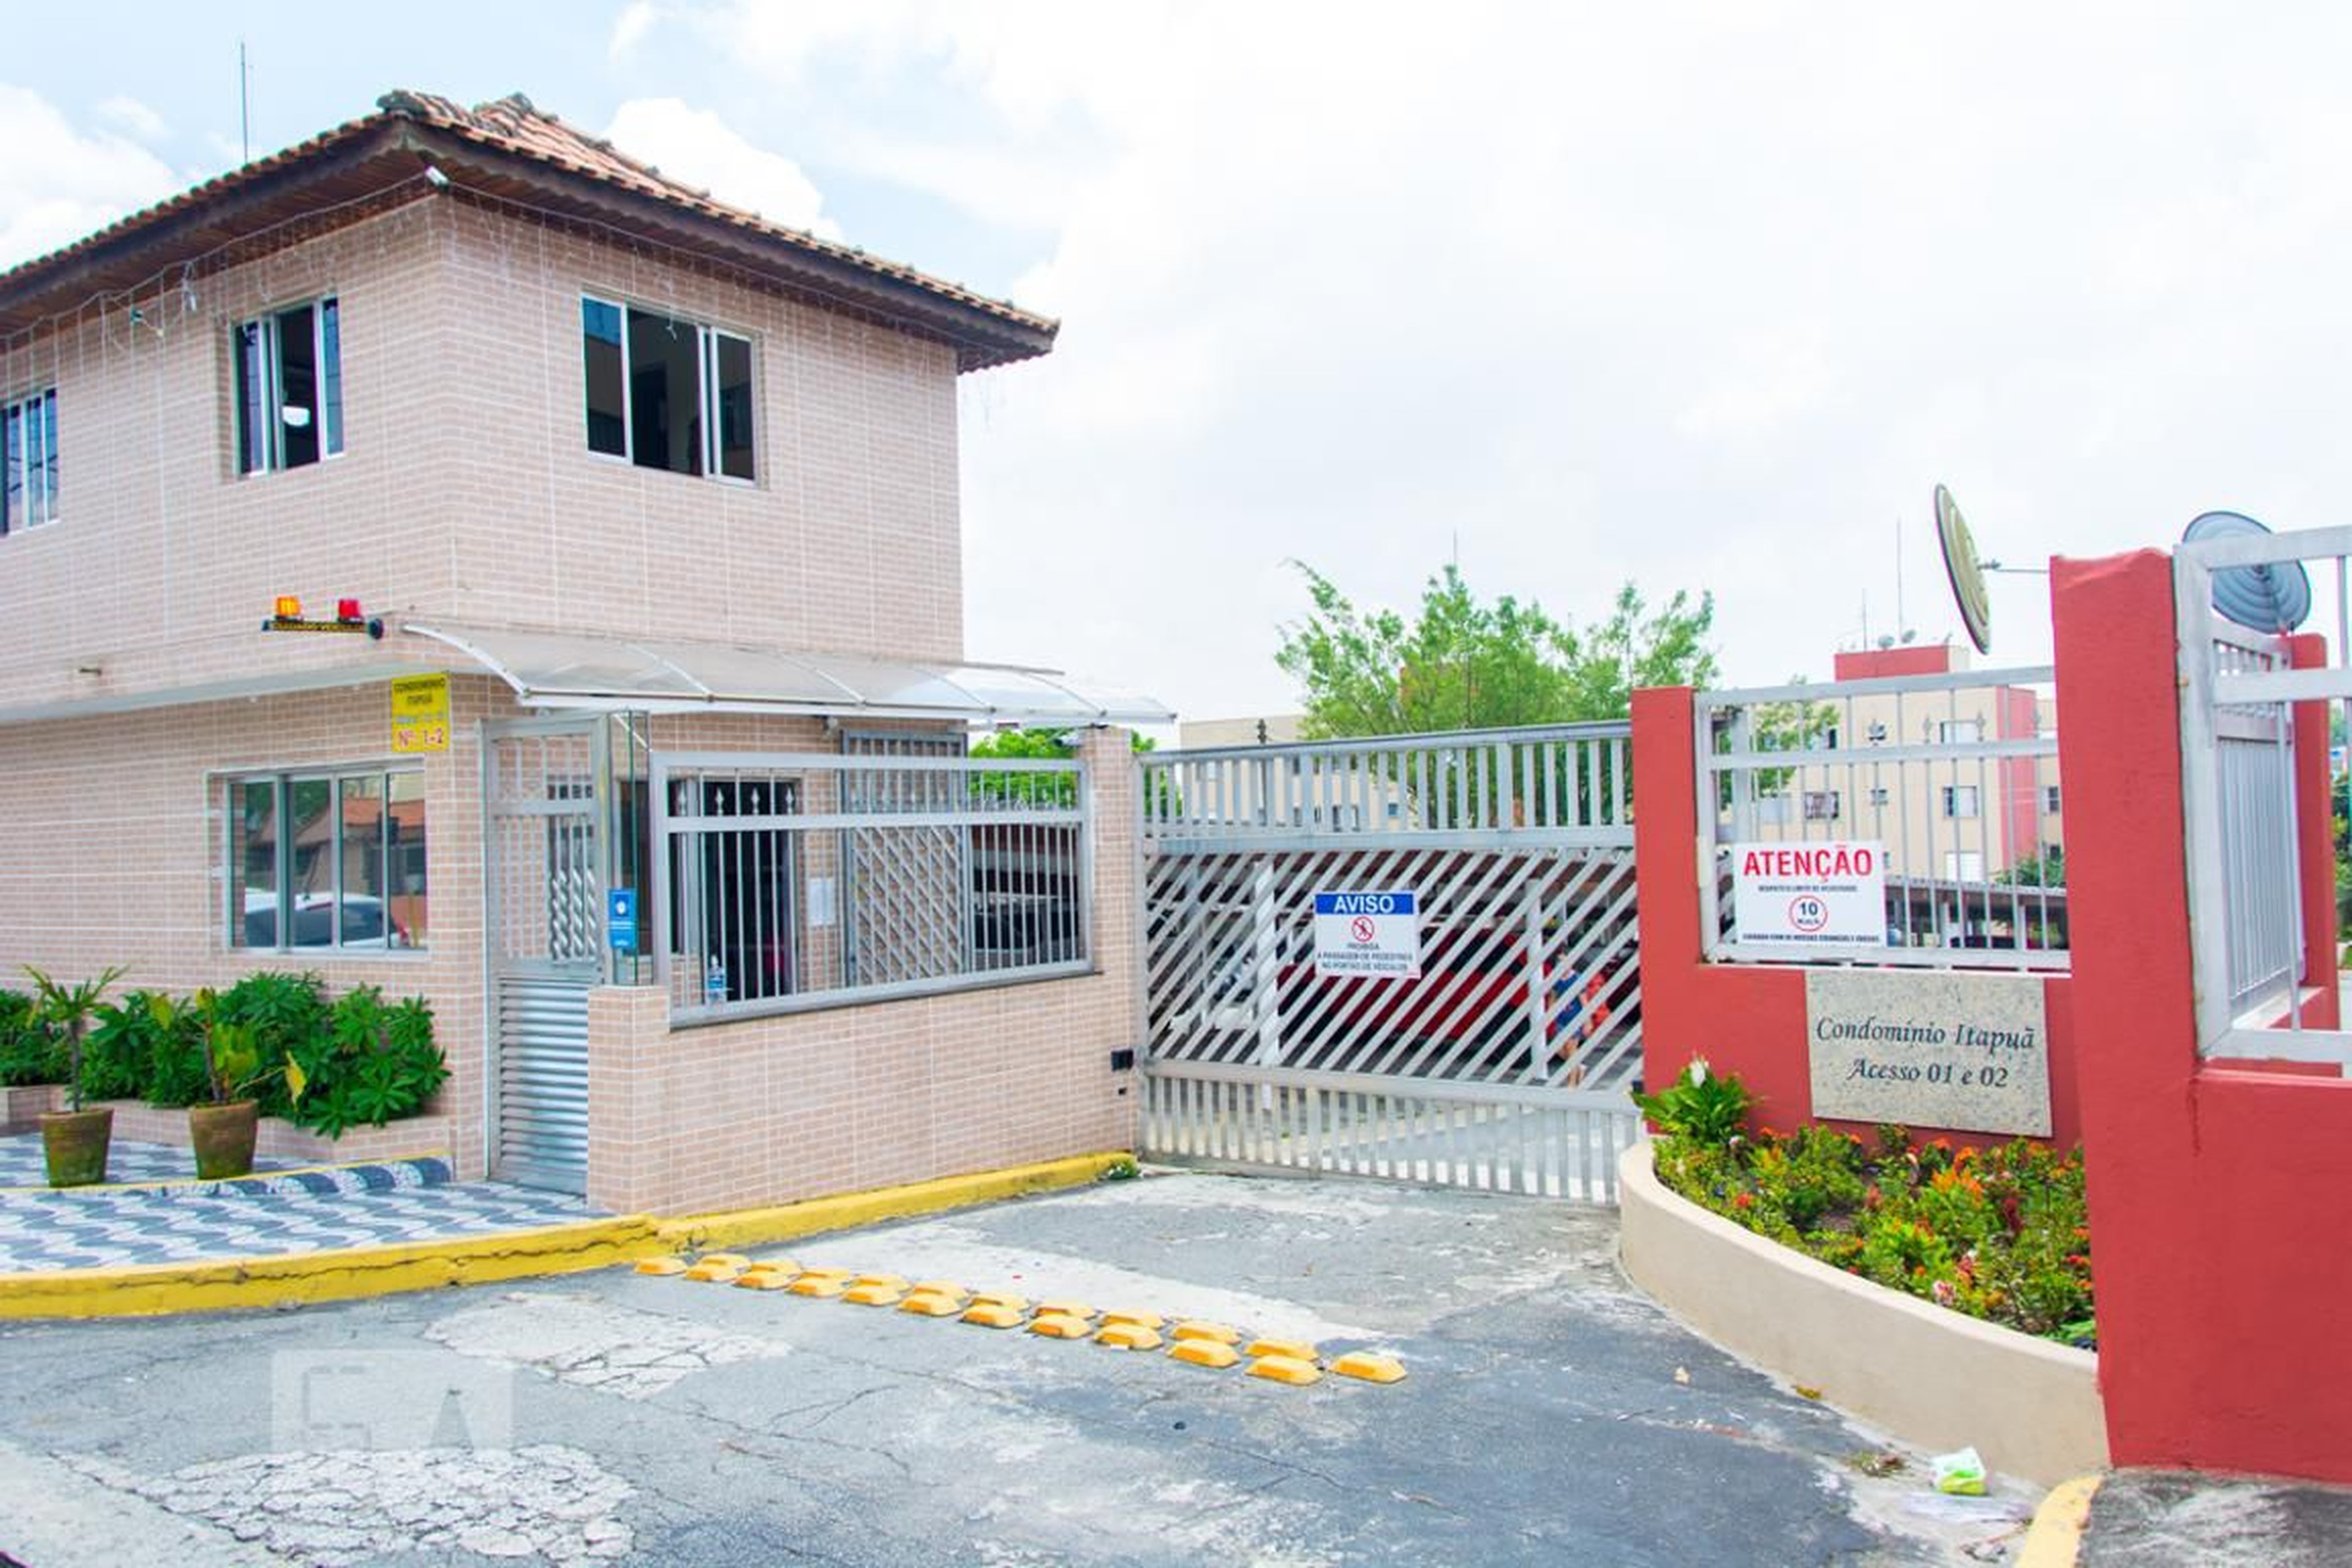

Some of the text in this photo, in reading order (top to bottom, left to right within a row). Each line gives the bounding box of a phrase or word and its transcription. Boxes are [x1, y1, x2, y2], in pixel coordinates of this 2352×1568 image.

[1744, 844, 1872, 882] ATENÇÃO
[1333, 895, 1395, 913] AVISO
[1799, 902, 1818, 916] 10
[1954, 1023, 2035, 1054] Itapuã
[1846, 1058, 2008, 1088] Acesso 01 e 02
